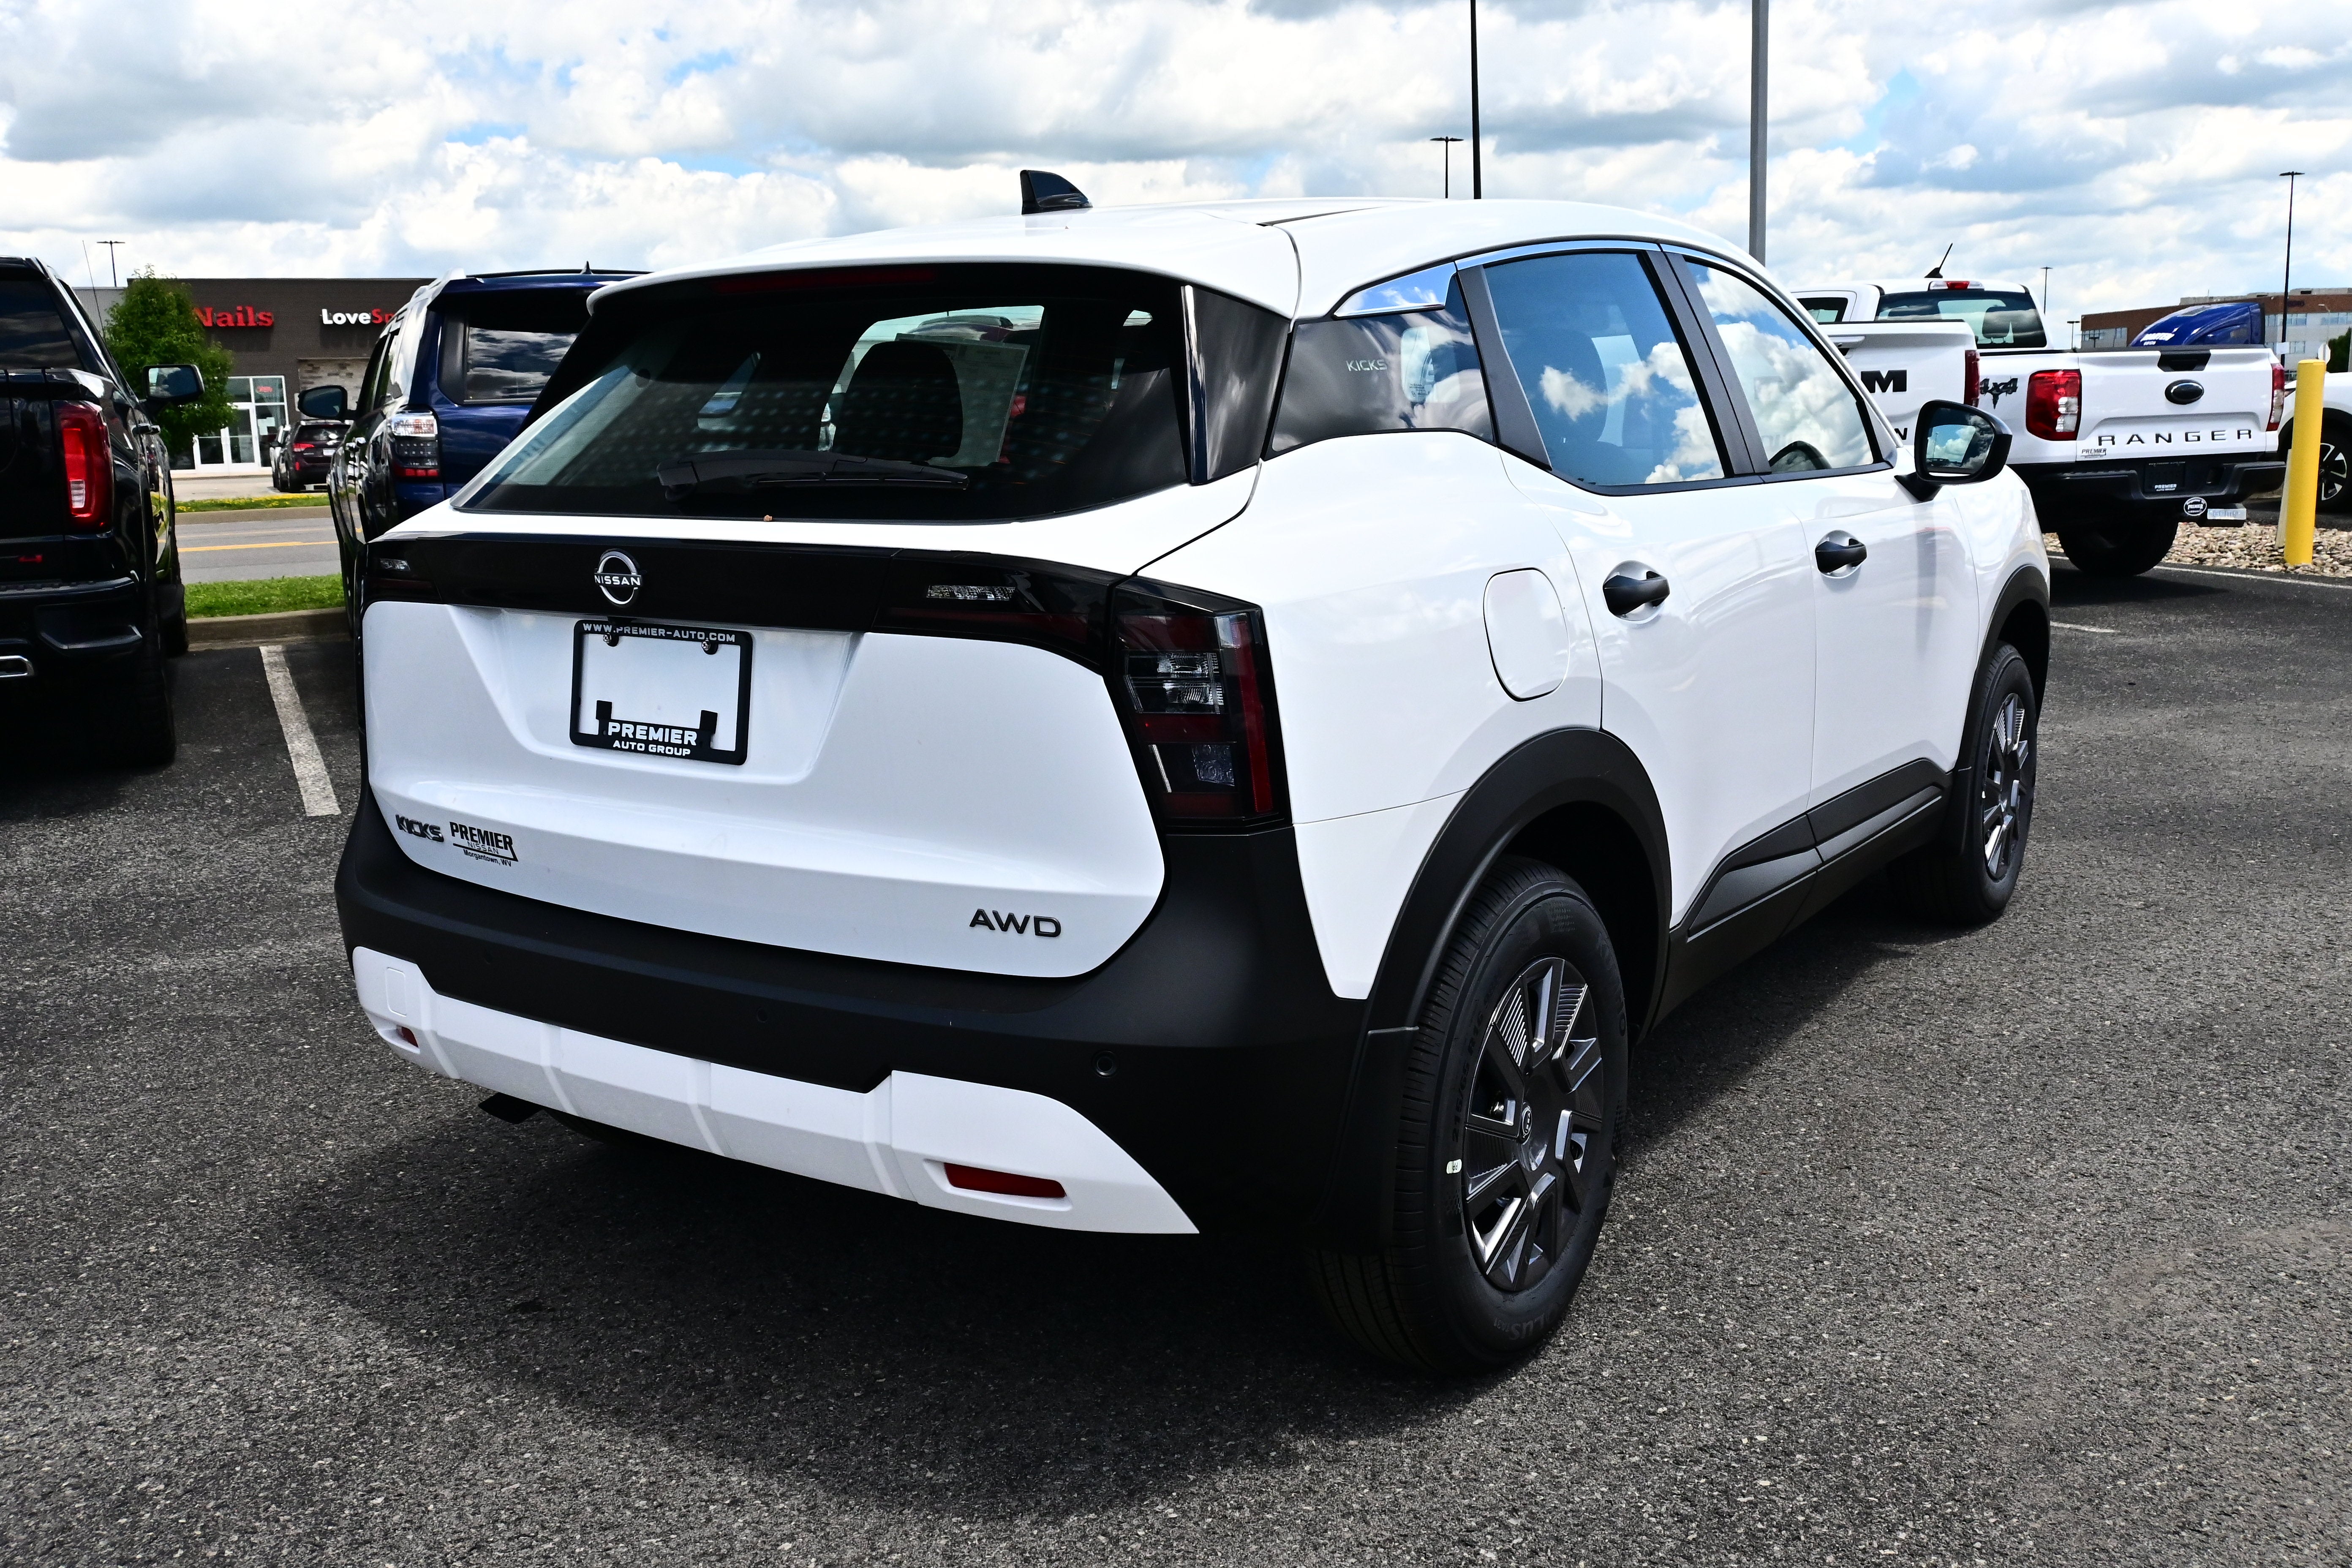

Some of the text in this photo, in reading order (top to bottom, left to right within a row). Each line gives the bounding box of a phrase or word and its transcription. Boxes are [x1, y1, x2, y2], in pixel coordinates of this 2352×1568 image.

[193, 305, 274, 327] Nails
[1345, 359, 1387, 371] KICKS
[2098, 429, 2251, 446] RANGER
[594, 574, 640, 585] NISSAN
[583, 623, 735, 642] WWW.PREMIER-AUTO.COM
[608, 721, 697, 746] PREMIER
[613, 740, 691, 756] AUTO GROUP
[395, 814, 444, 842] KICKS
[449, 821, 514, 851] PREMIER
[467, 841, 499, 855] NISSAN
[463, 849, 511, 867] Morgantown, WV
[969, 908, 1062, 937] AWD
